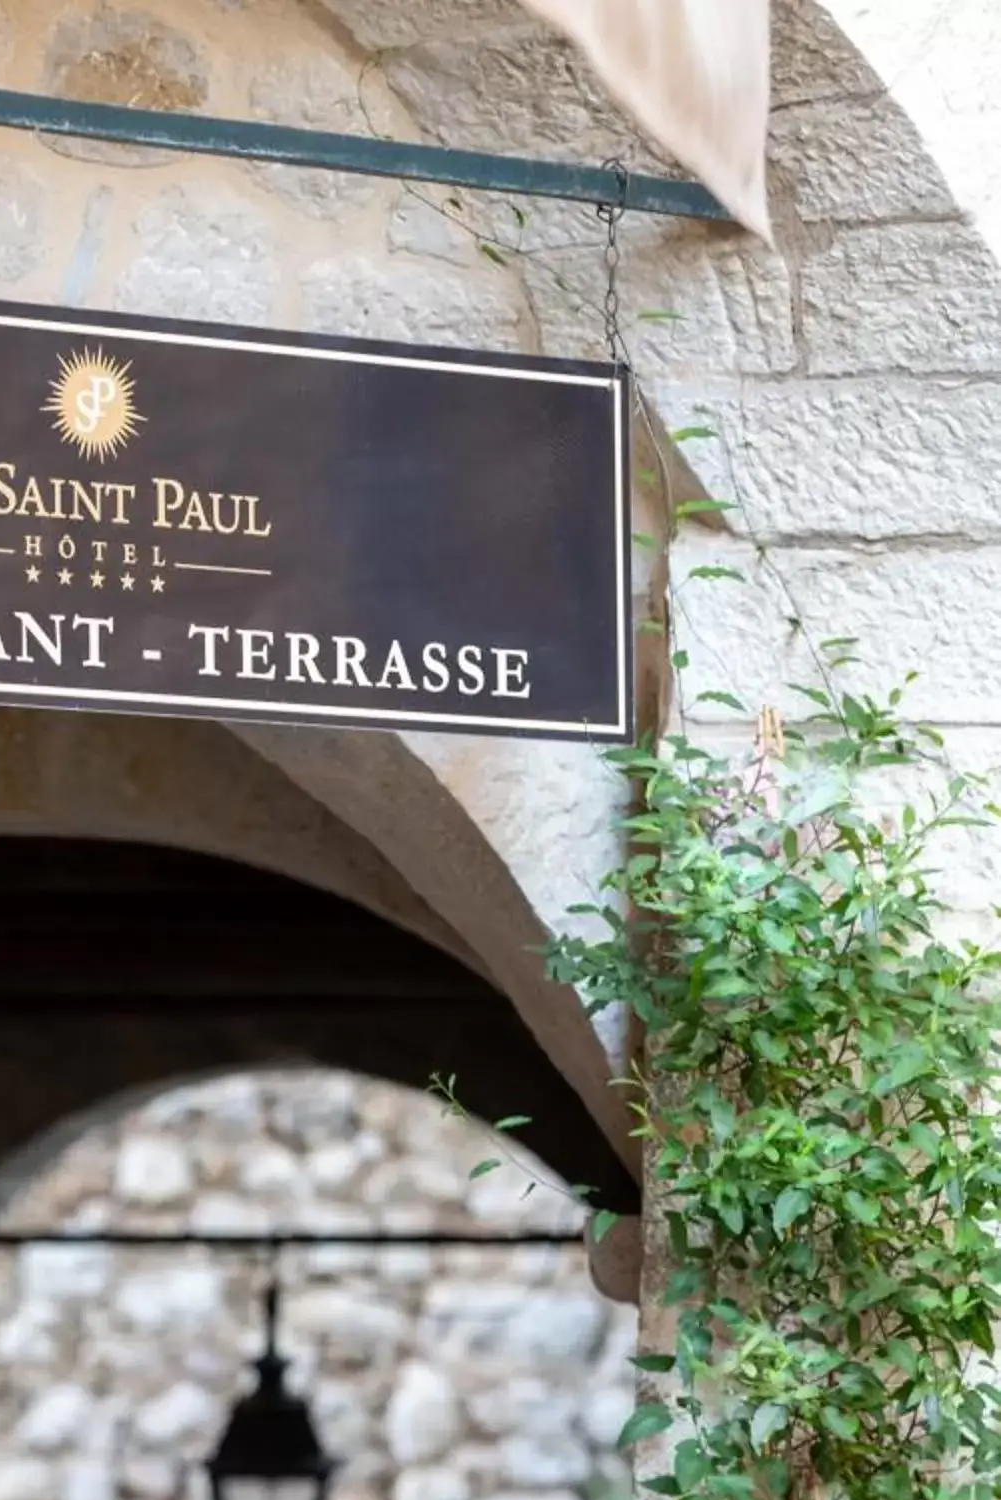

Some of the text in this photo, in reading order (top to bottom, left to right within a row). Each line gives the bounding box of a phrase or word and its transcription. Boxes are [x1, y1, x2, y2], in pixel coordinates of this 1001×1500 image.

[151, 477, 272, 537] PAUL
[24, 534, 166, 567] HÔTEL
[187, 622, 531, 699] TERRASSE
